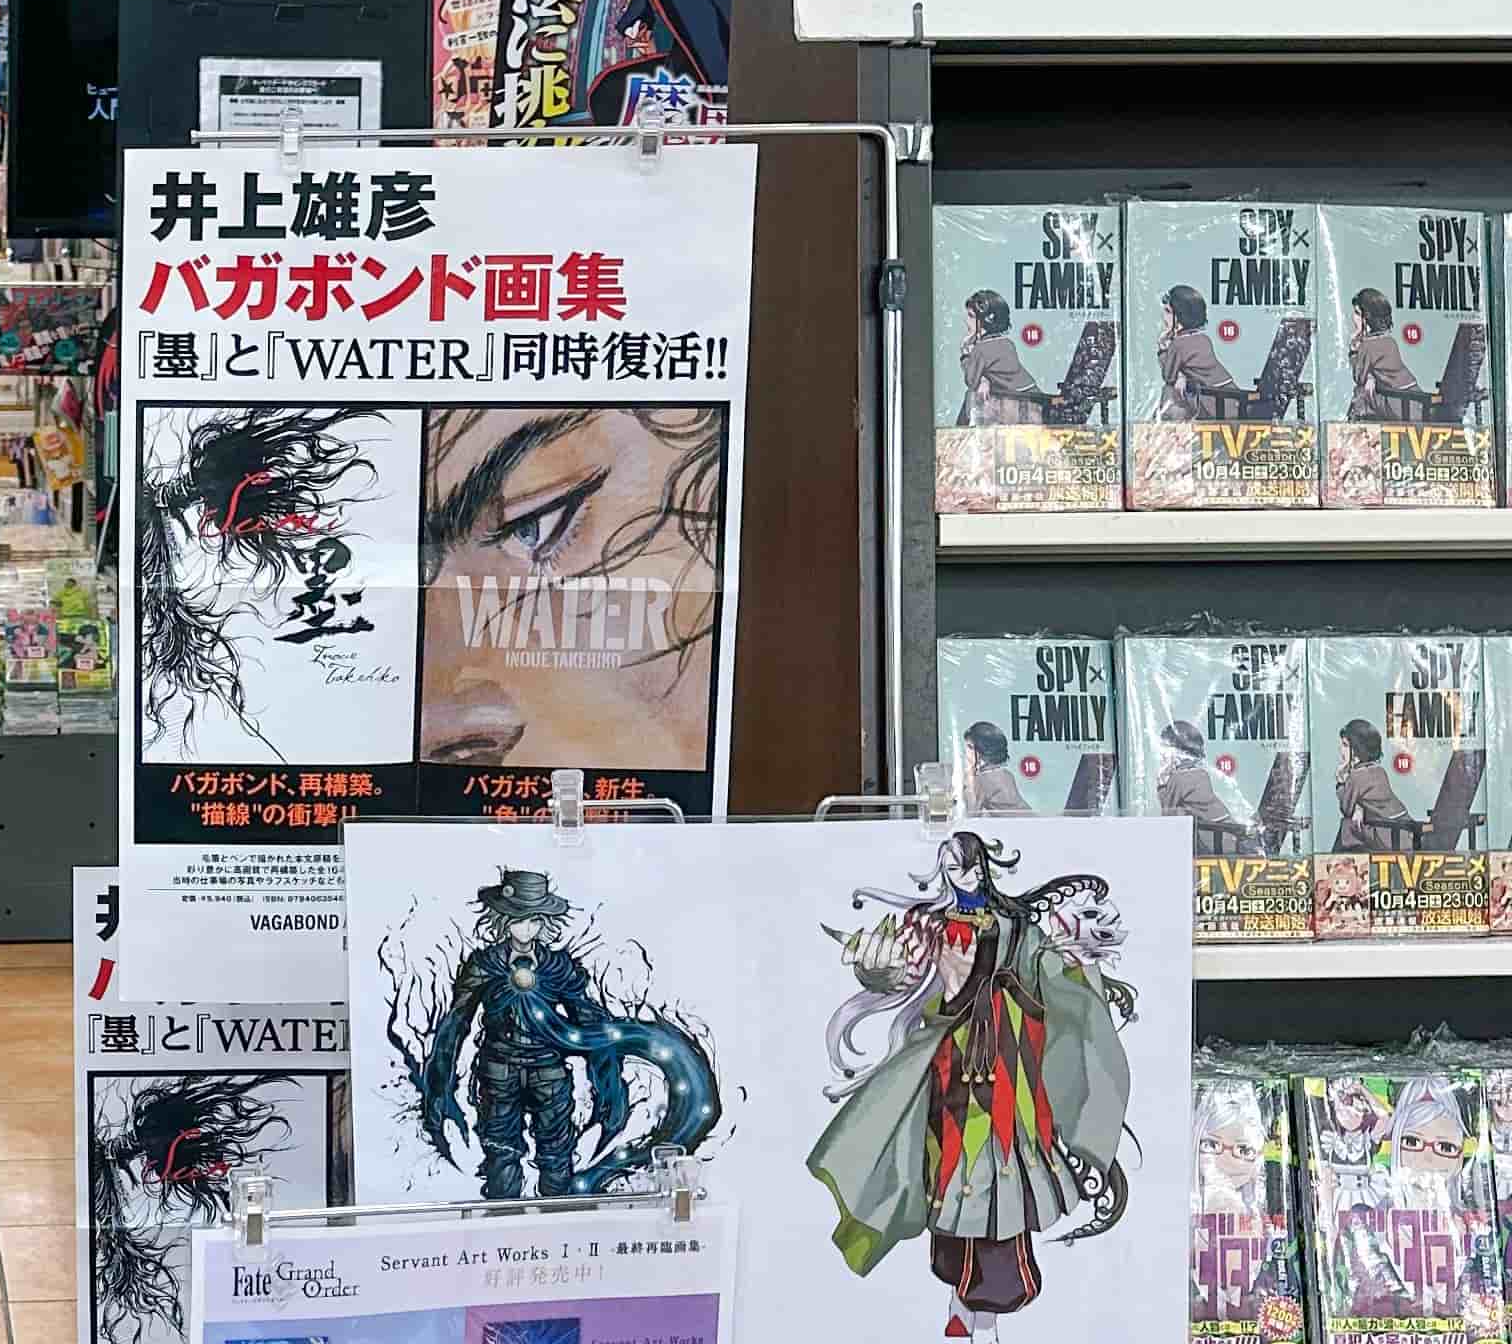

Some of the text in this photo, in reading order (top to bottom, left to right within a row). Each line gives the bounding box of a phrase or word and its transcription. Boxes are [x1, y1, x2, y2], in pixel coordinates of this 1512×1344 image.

[150, 170, 437, 242] 井上雄彦
[140, 250, 628, 322] バガボンド画集
[1014, 261, 1114, 311] FAMILY
[1210, 257, 1311, 307] FAMILY
[1394, 262, 1481, 312] FAMILY
[456, 573, 674, 652] WATER
[1009, 694, 1107, 742] FAMILY
[1207, 692, 1297, 741] FAMILY
[1385, 691, 1481, 739] FAMILY
[170, 771, 384, 797] バガボンド、再構築。
[1194, 858, 1310, 896] TVアニメ
[1370, 856, 1487, 893] TVアニメ
[250, 914, 339, 931] VAGABOND
[87, 1013, 351, 1055] 『墨』と『WATE
[232, 1265, 273, 1298] Fate
[276, 1260, 337, 1282] Grand
[380, 1254, 450, 1273] Servant
[456, 1251, 489, 1266] Art
[496, 1247, 550, 1263] Works
[301, 1279, 360, 1299] Order
